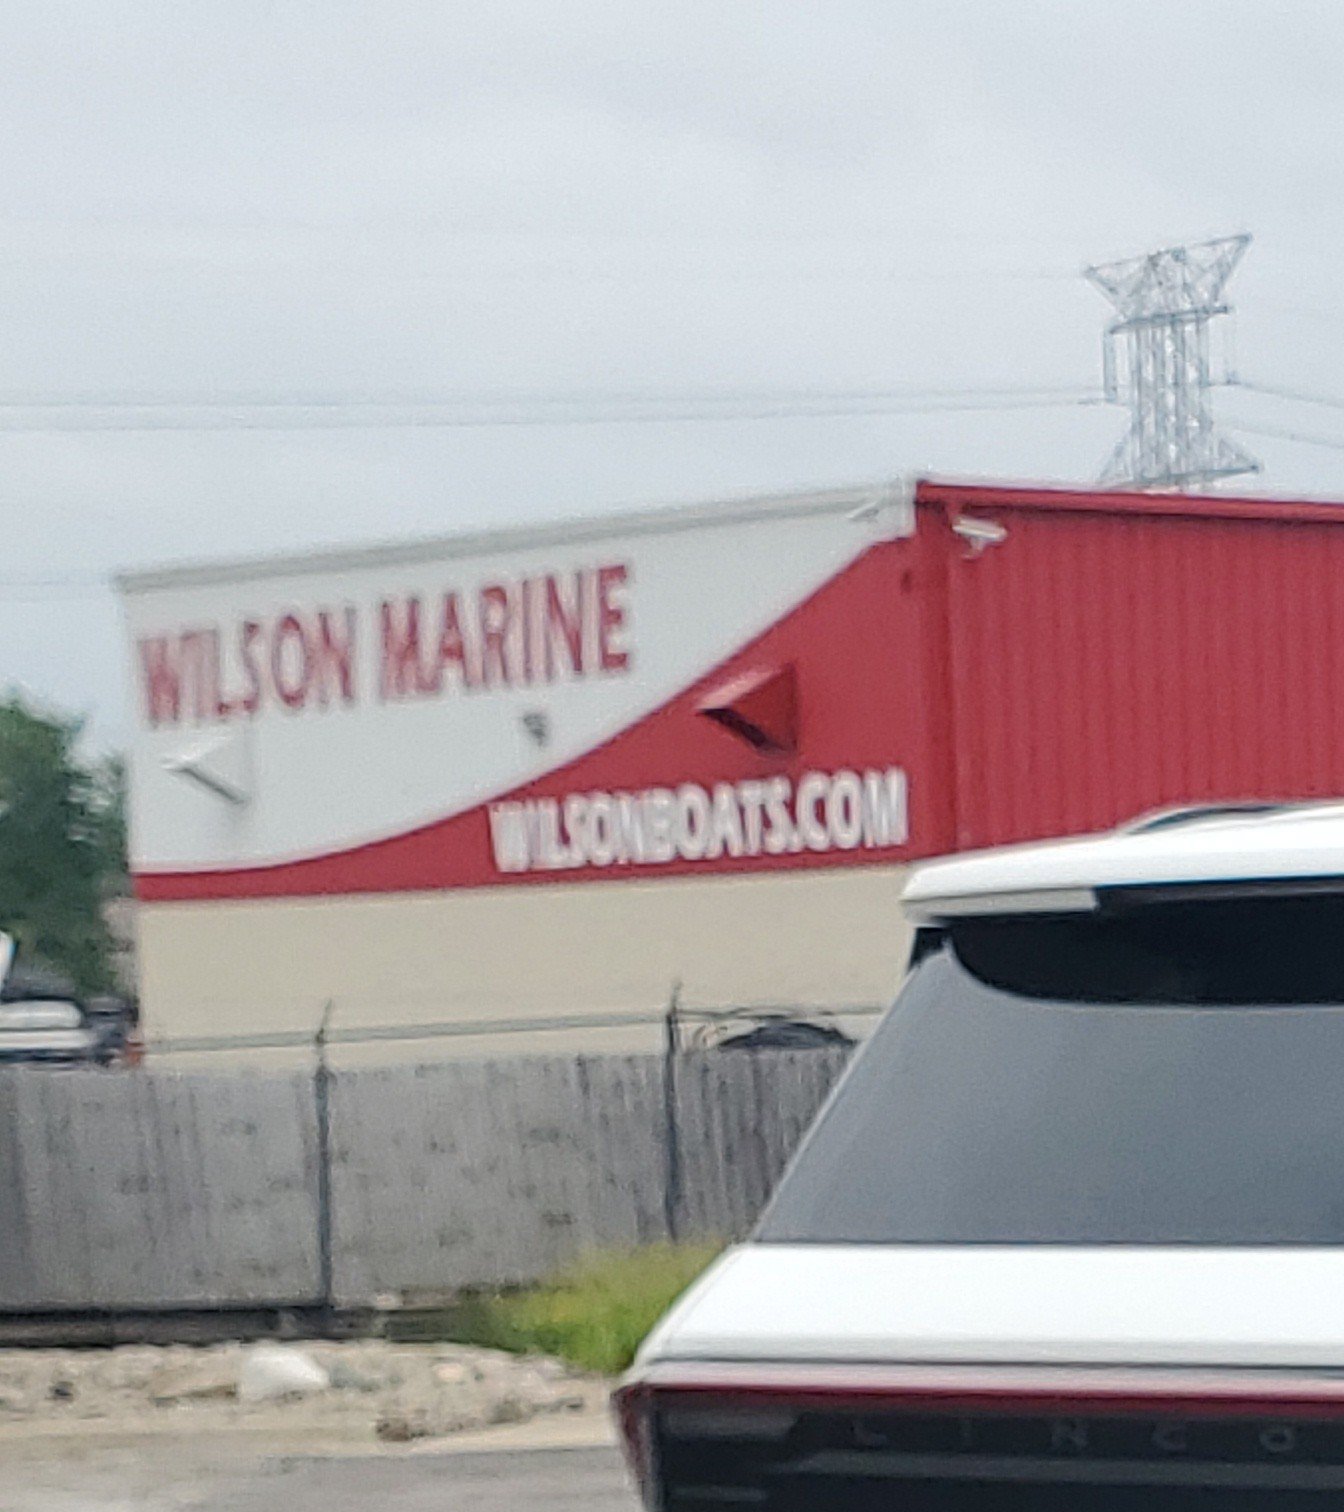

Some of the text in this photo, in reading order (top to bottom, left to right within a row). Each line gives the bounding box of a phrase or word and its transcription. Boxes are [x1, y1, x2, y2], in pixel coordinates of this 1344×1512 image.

[137, 565, 631, 728] WILSON MARINE
[489, 768, 908, 873] WILSONBOATS.COM
